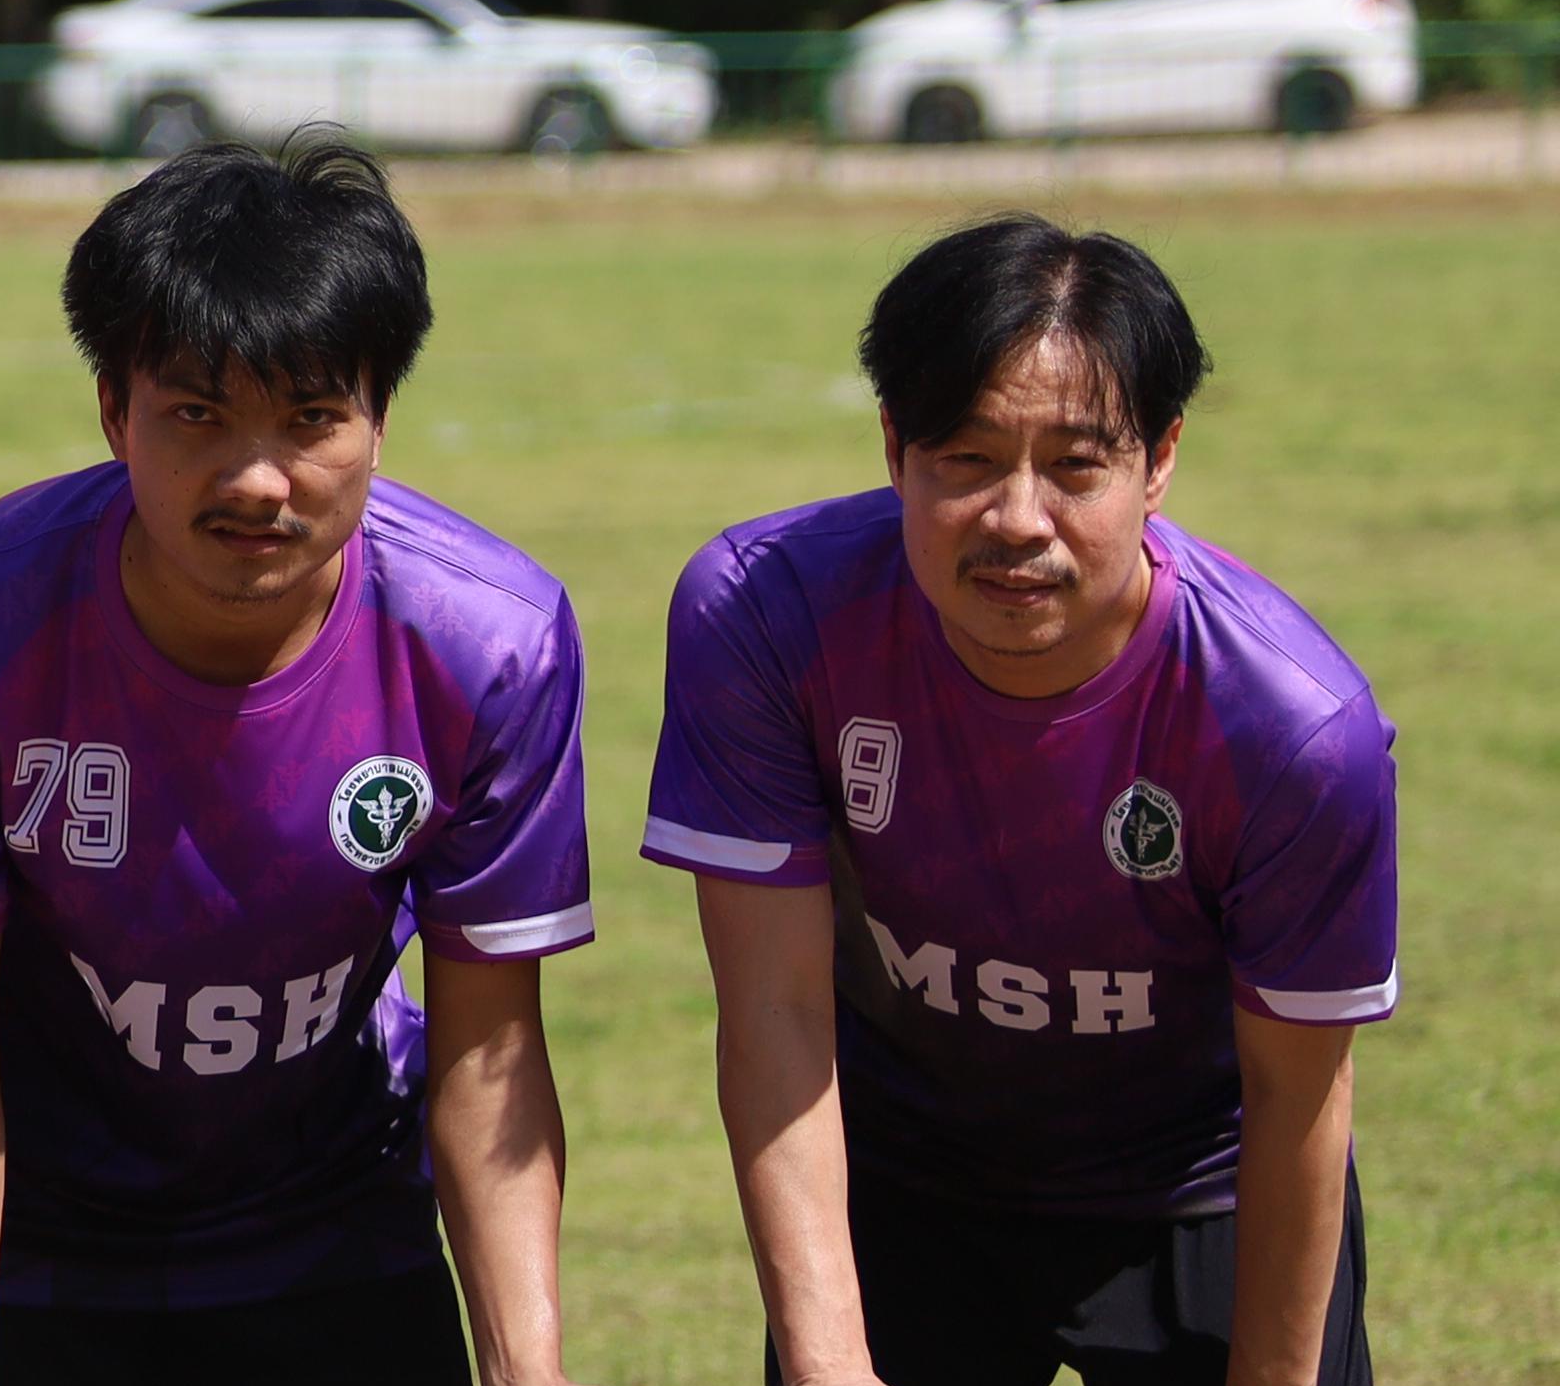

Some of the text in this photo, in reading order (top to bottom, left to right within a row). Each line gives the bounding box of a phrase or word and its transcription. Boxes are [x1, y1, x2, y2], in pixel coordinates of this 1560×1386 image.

[4, 738, 130, 869] 79
[70, 952, 354, 1075] MSH
[865, 912, 1156, 1034] MSH
